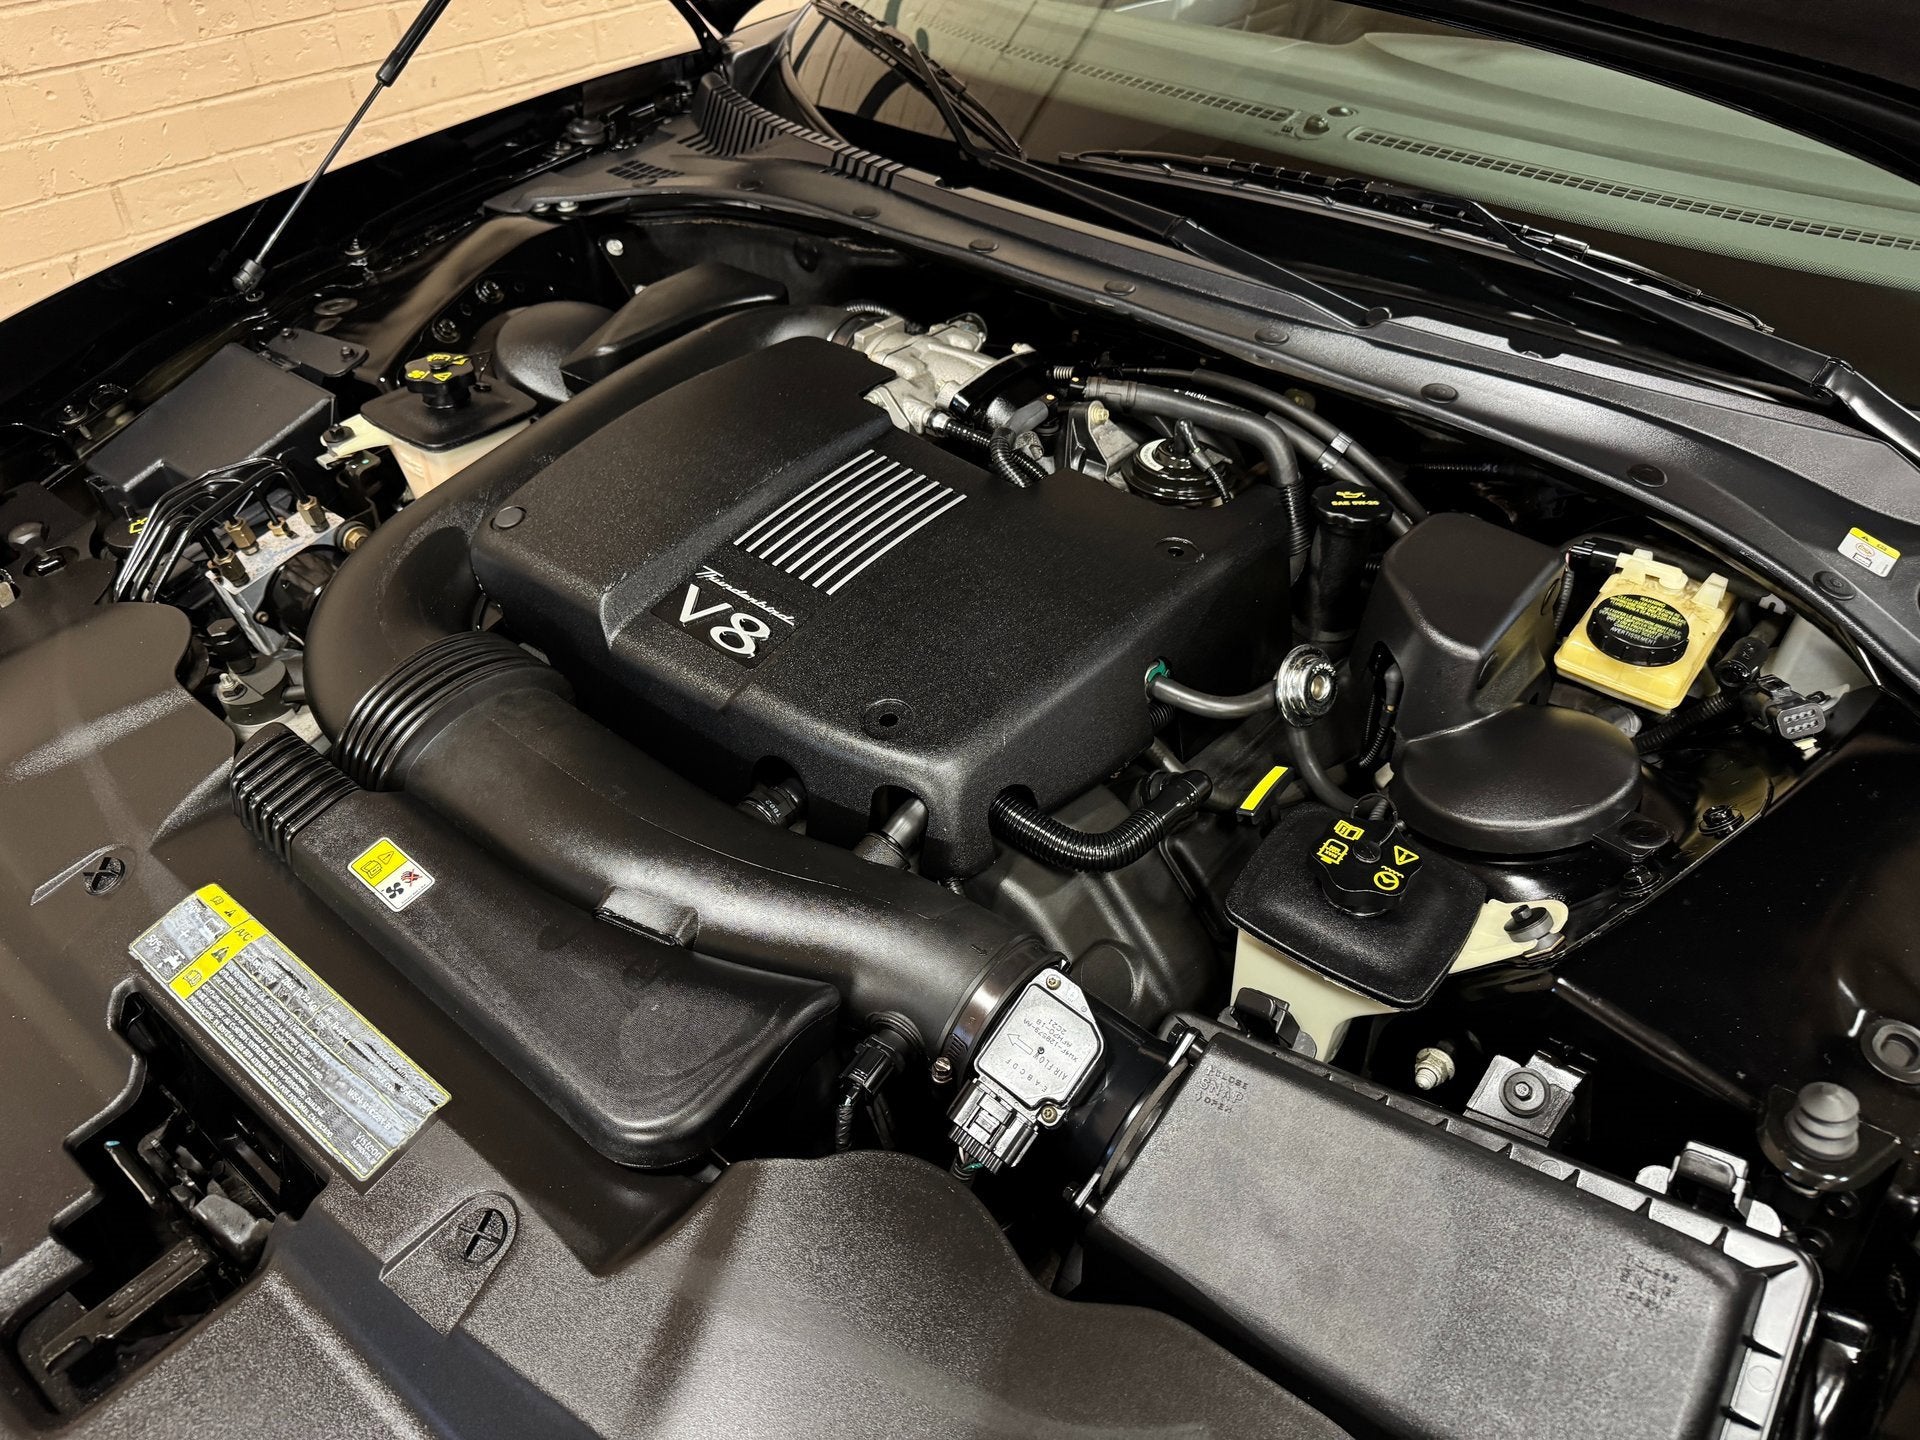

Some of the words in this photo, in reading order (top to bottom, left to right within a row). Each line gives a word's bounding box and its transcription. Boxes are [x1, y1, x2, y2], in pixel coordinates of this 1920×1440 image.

[695, 565, 795, 627] Thunderbird
[680, 584, 771, 657] V8
[1609, 625, 1656, 646] AVERTISSEMENT
[144, 933, 166, 952] 50%
[233, 925, 253, 943] A/C
[1049, 1019, 1067, 1035] 2C21
[1033, 1052, 1054, 1071] FLOW
[1054, 1069, 1068, 1080] AIR
[1200, 1077, 1244, 1103] SNAP
[353, 1130, 384, 1160] Visteon
